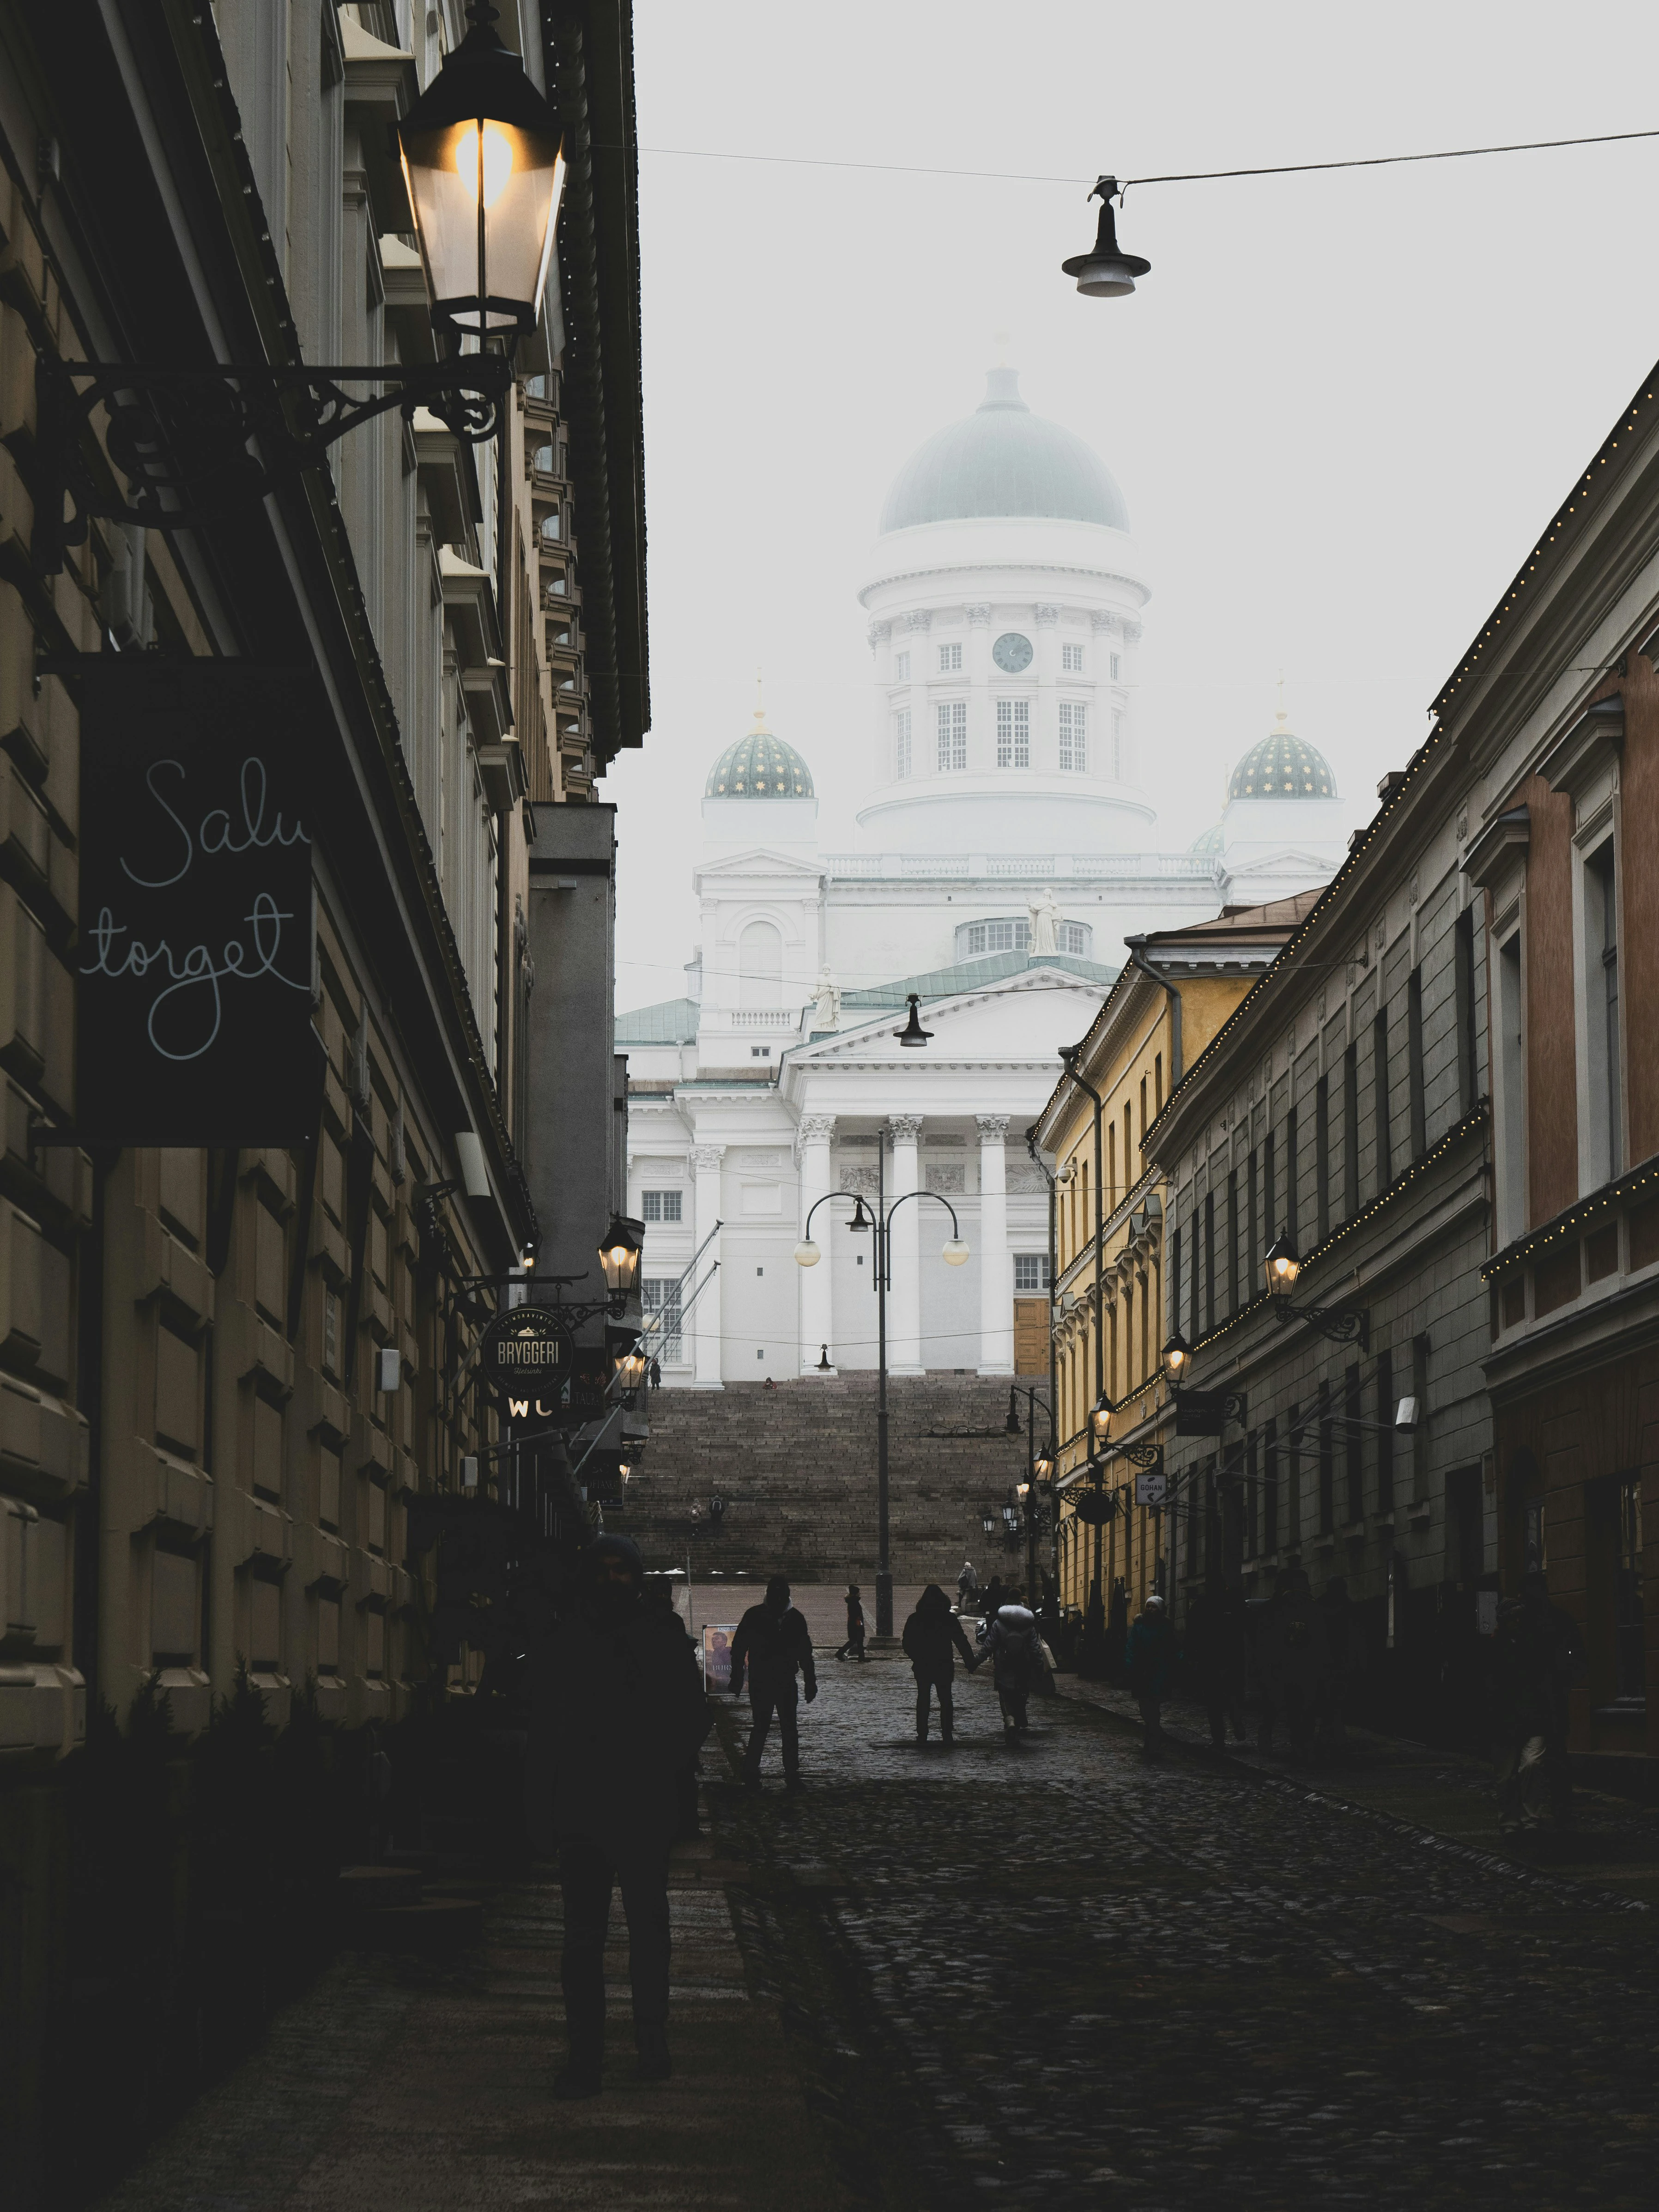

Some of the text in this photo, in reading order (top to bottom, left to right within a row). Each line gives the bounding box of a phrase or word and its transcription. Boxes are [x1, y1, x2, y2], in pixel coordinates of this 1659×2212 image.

[79, 892, 311, 1061] torget
[497, 1313, 559, 1331] PANIMORAVINTOLA
[498, 1341, 559, 1364] BRYGGERI
[497, 1376, 517, 1391] BREWERY
[532, 1375, 560, 1393] RESTAURANT
[508, 1397, 553, 1418] WC
